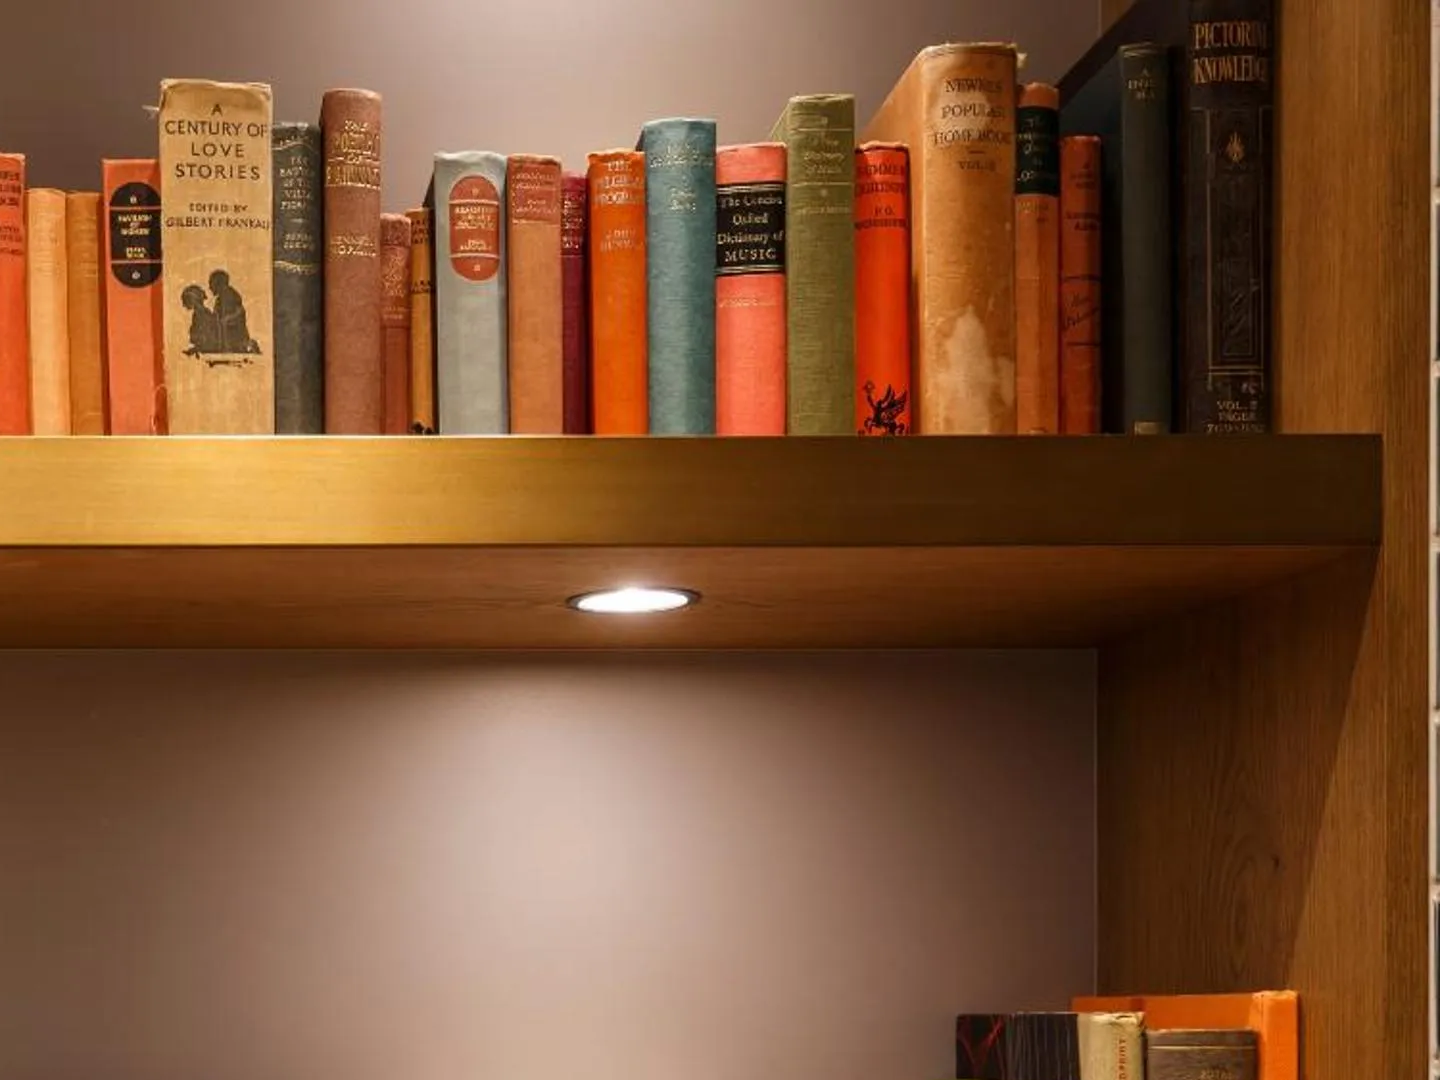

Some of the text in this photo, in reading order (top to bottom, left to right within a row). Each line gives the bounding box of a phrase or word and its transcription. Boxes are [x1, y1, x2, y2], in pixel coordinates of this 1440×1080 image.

[1194, 21, 1267, 50] PICTORI
[1193, 56, 1268, 84] KNOWLEDG
[211, 104, 224, 115] A
[165, 120, 268, 137] CENTURY OF
[191, 143, 245, 158] LOVE
[175, 164, 260, 180] STORIES
[189, 203, 248, 214] EDITED BY
[166, 217, 214, 228] GILBERT
[724, 249, 776, 263] MUSIC
